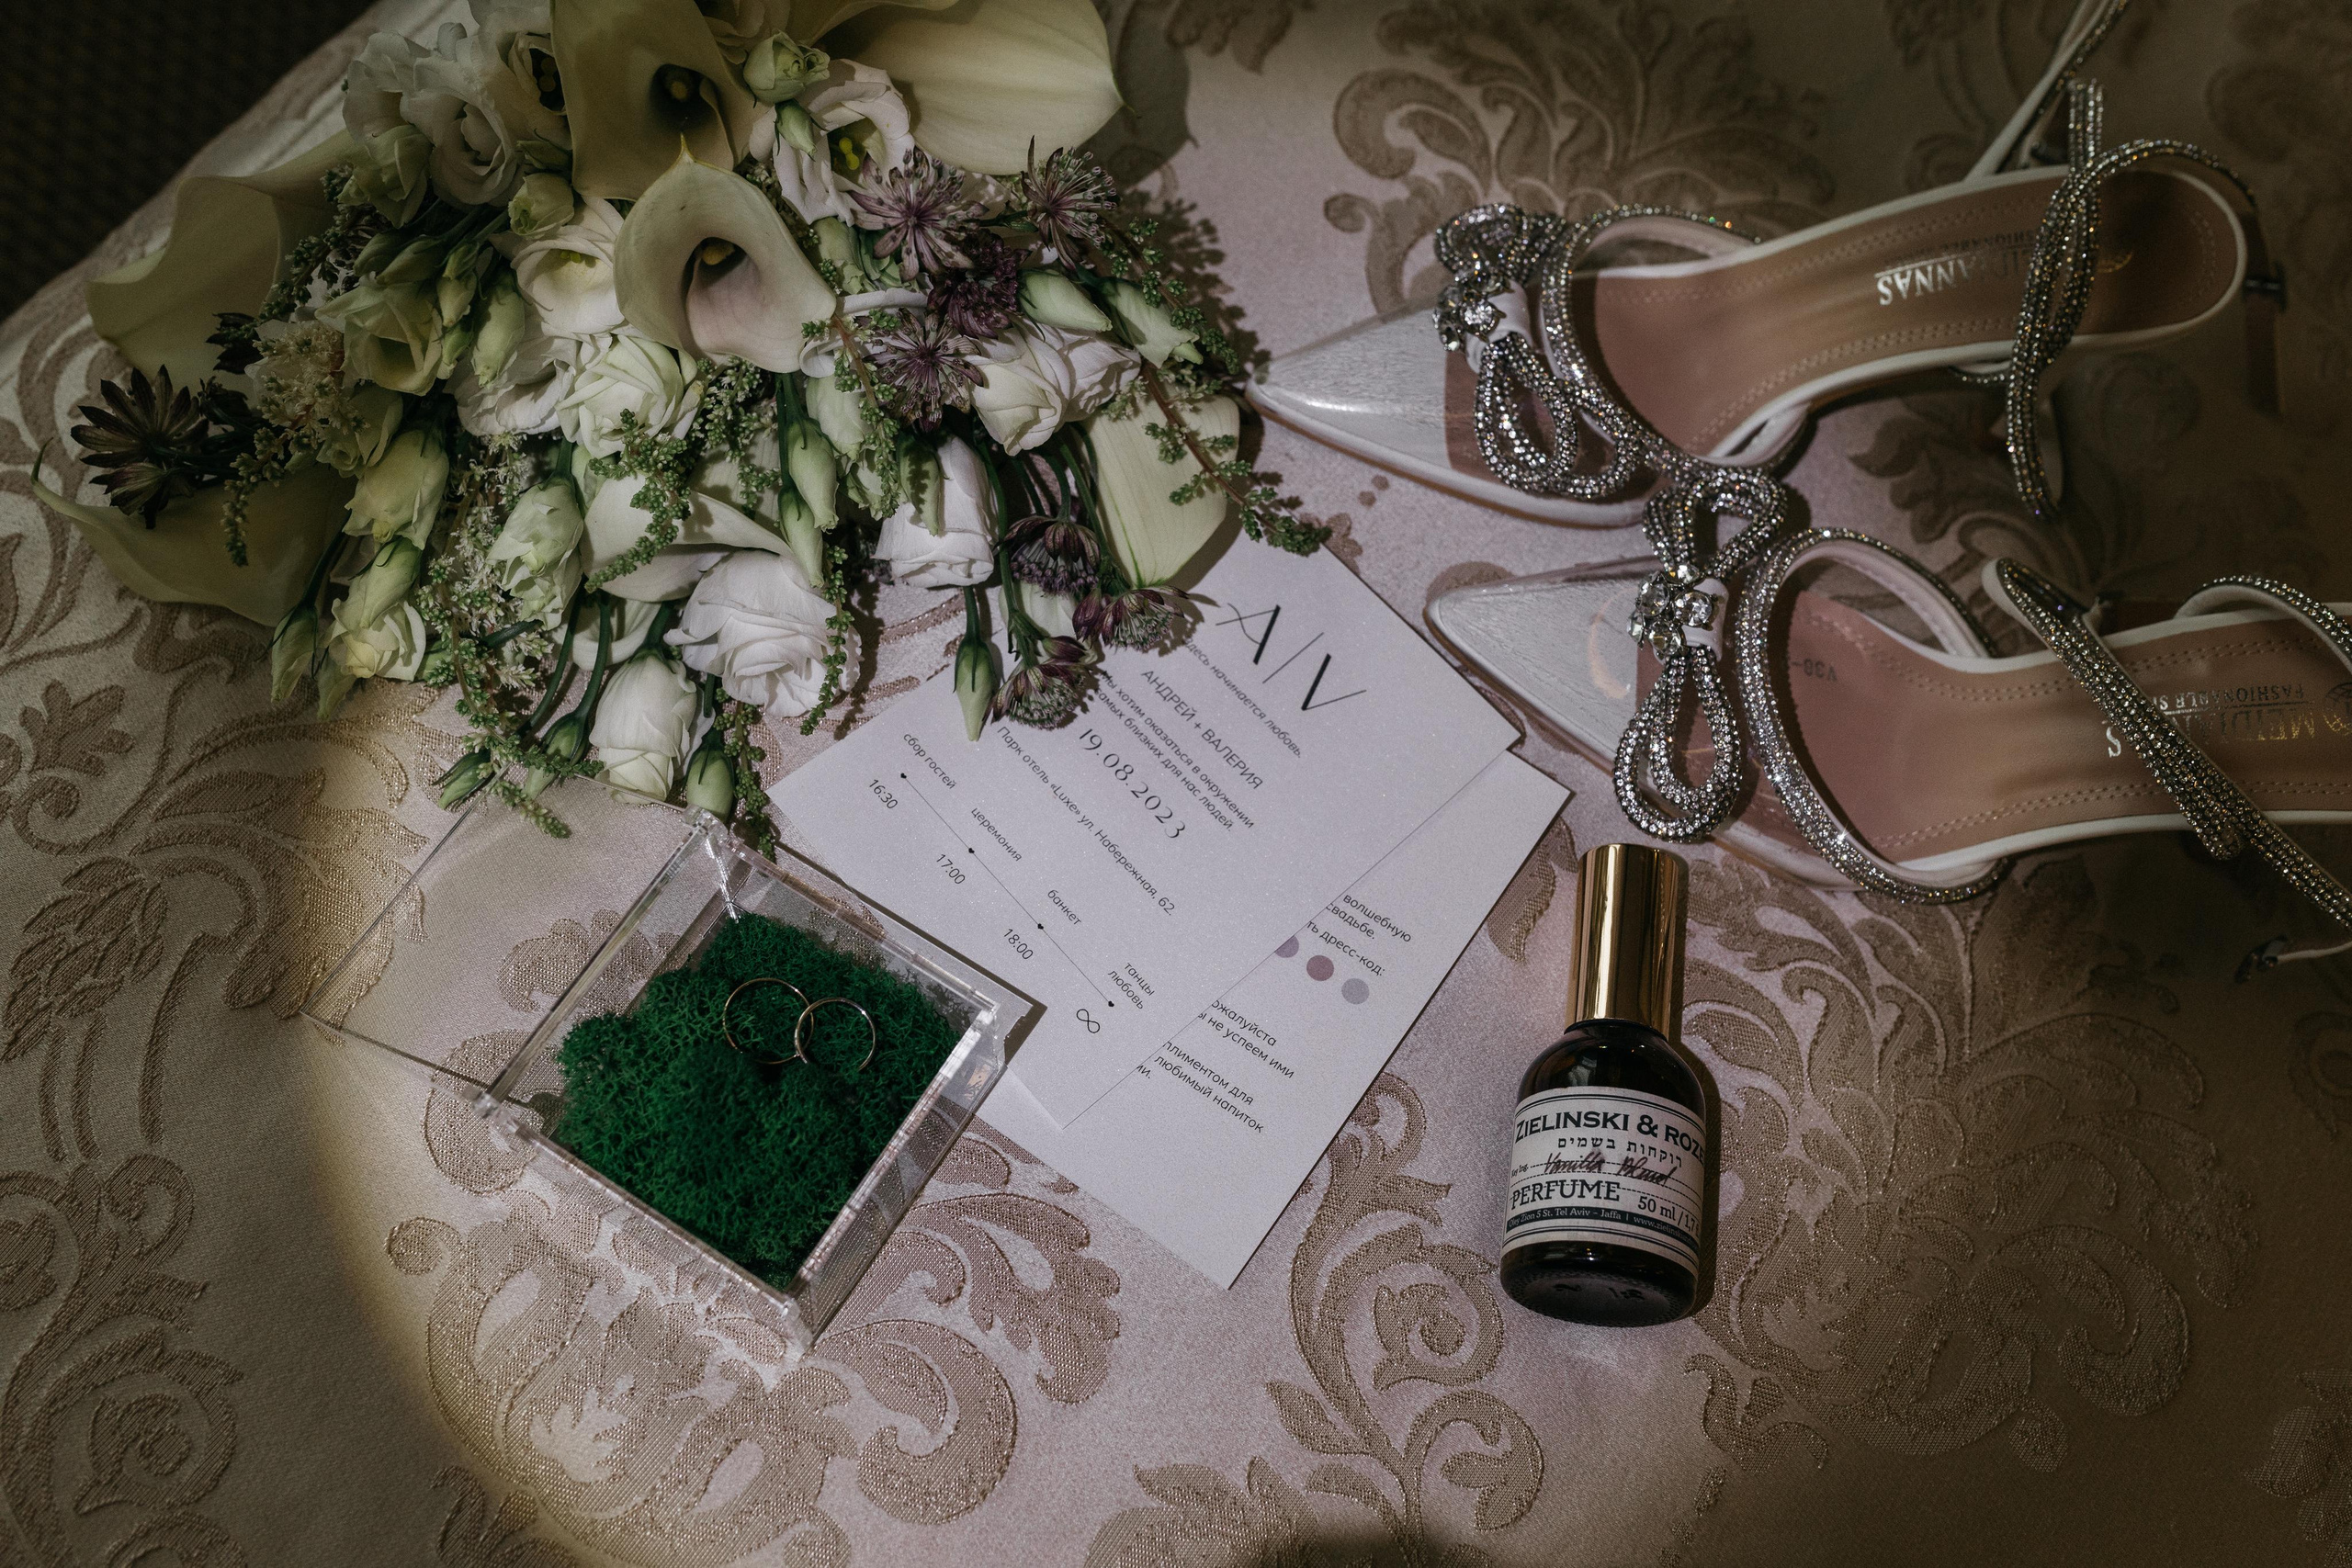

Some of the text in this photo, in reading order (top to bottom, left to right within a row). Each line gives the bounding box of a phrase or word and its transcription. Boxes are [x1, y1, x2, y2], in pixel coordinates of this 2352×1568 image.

[1141, 671, 1195, 722] АНДРЕЙ
[1202, 729, 1263, 789] ВАЛЕРИЯ
[1210, 665, 1266, 720] начинается
[1264, 716, 1302, 758] любовь.
[903, 733, 957, 789] сбор гостей
[1098, 690, 1235, 832] самых близких для нас людей.
[1115, 688, 1146, 718] хотим
[1144, 716, 1193, 767] оказаться
[1192, 765, 1201, 774] в
[1199, 773, 1254, 829] окружении
[869, 779, 899, 809] 16:30
[1079, 728, 1186, 839] 19.08.2023
[970, 807, 1023, 862] церемония
[997, 727, 1176, 916] Парк отель «Luxe» ул. Набережная, 62.
[936, 853, 966, 885] 17:00
[1047, 889, 1082, 925] банкет
[1326, 903, 1375, 940] свадьбе.
[1343, 895, 1412, 942] волшебную
[1003, 928, 1034, 960] 18:00
[1319, 931, 1385, 976] дресс-код:
[1107, 969, 1144, 1010] любовь
[1124, 962, 1155, 997] танцы
[1207, 1017, 1225, 1032] не
[1223, 1028, 1269, 1062] успеем
[1269, 1057, 1295, 1079] ими
[1154, 1055, 1264, 1134] любимый напиток
[1228, 1085, 1254, 1106] для
[1515, 1111, 1629, 1144] ZIELINSKI
[1637, 1114, 1658, 1138] &
[1558, 1137, 1682, 1168] רוקחות בשמים
[1510, 1179, 1620, 1210] PERFUME
[1638, 1196, 1657, 1213] 50
[1659, 1205, 1676, 1221] ml
[1536, 1210, 1542, 1218] 5
[1543, 1209, 1553, 1217] St.
[1555, 1208, 1567, 1216] Tel
[1569, 1208, 1590, 1216] Aviv
[1600, 1209, 1622, 1220] Jaffa
